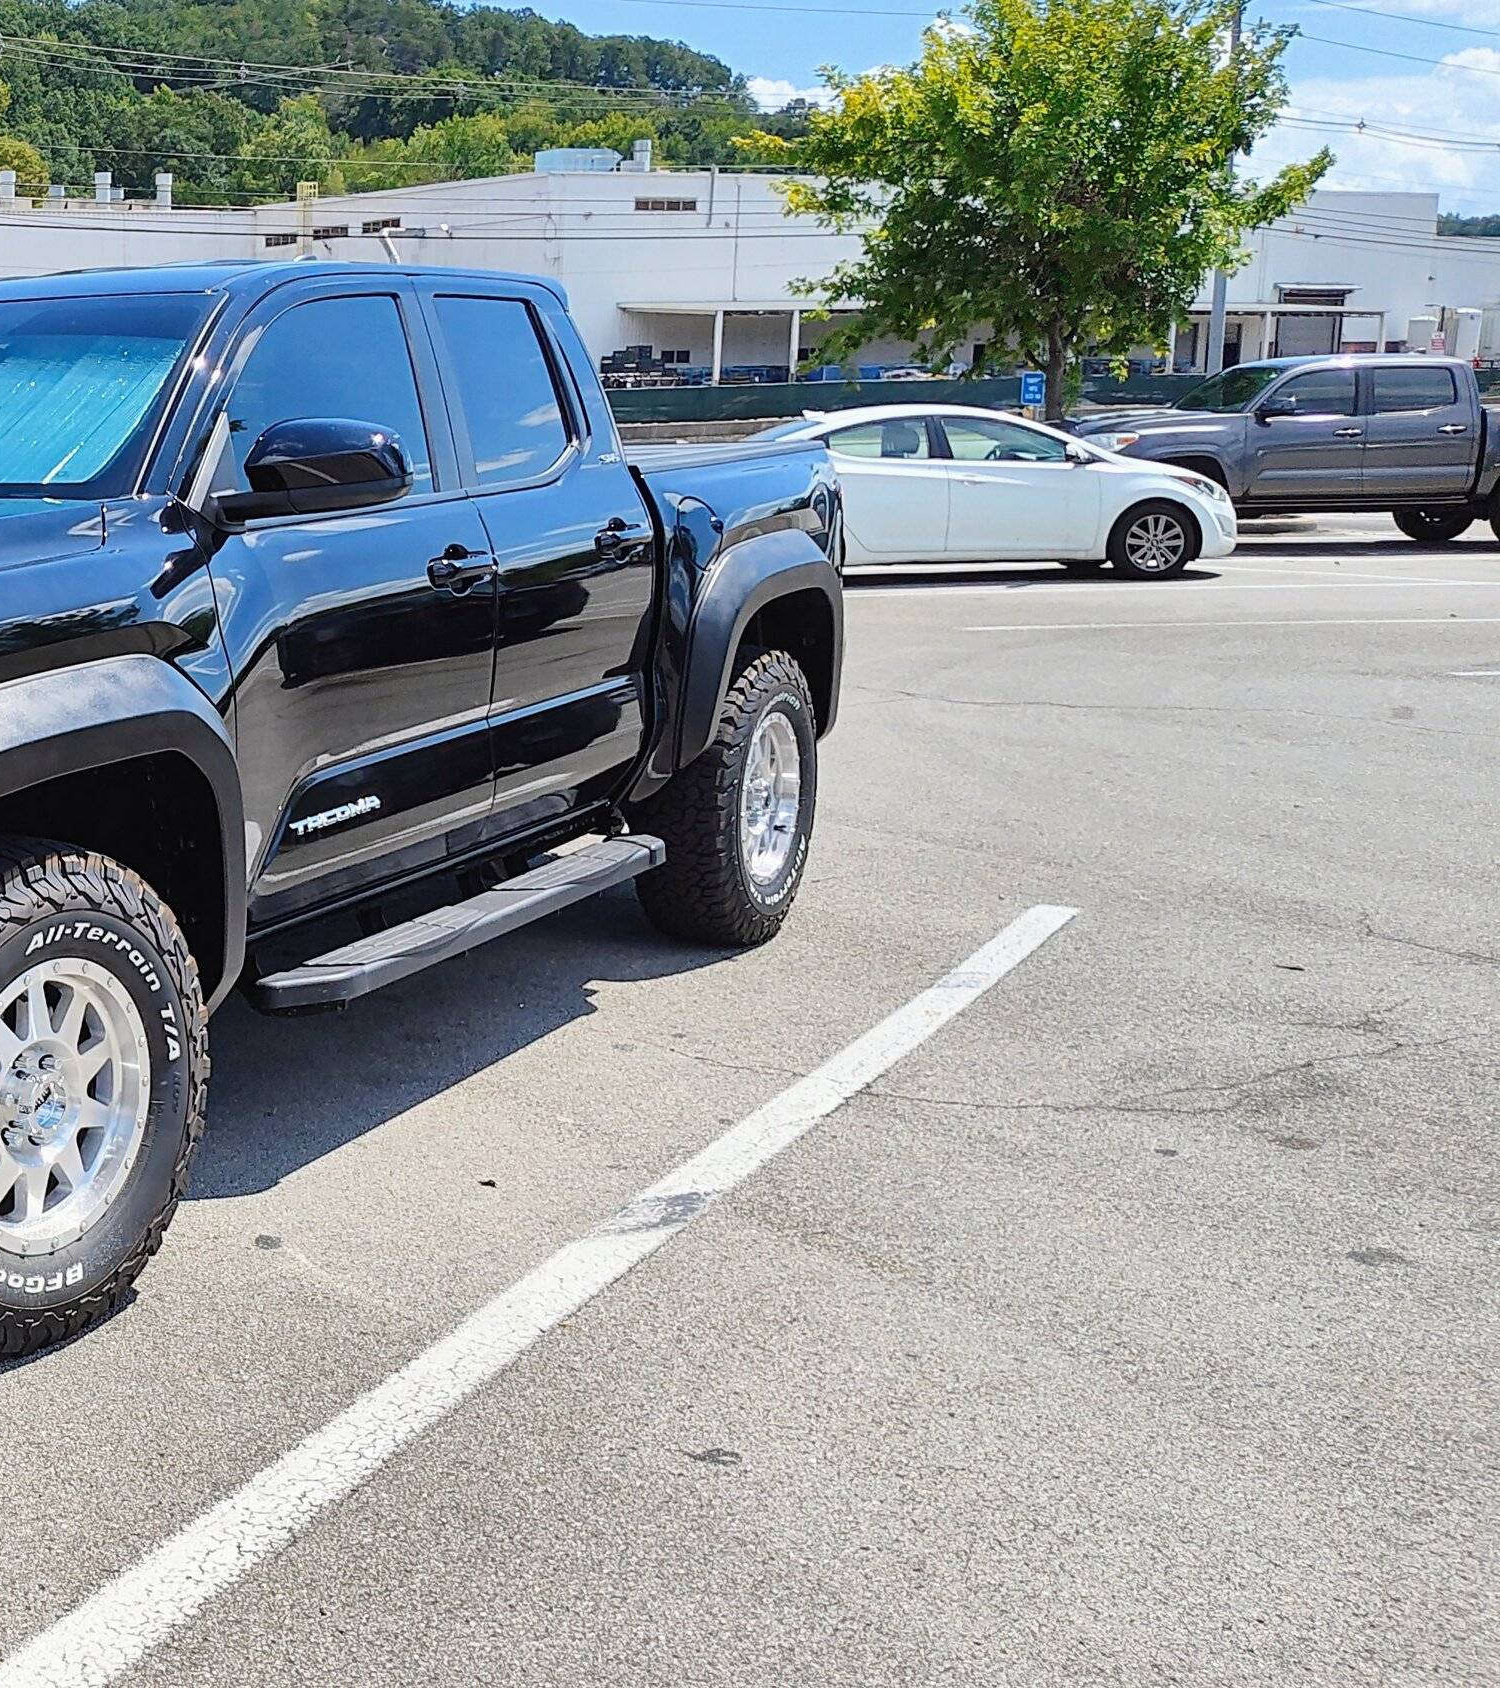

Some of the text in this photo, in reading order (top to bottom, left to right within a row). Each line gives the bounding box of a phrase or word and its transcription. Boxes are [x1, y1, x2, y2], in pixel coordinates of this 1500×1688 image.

[289, 795, 381, 836] TACOMA
[25, 922, 181, 1061] All-Terrain T/A
